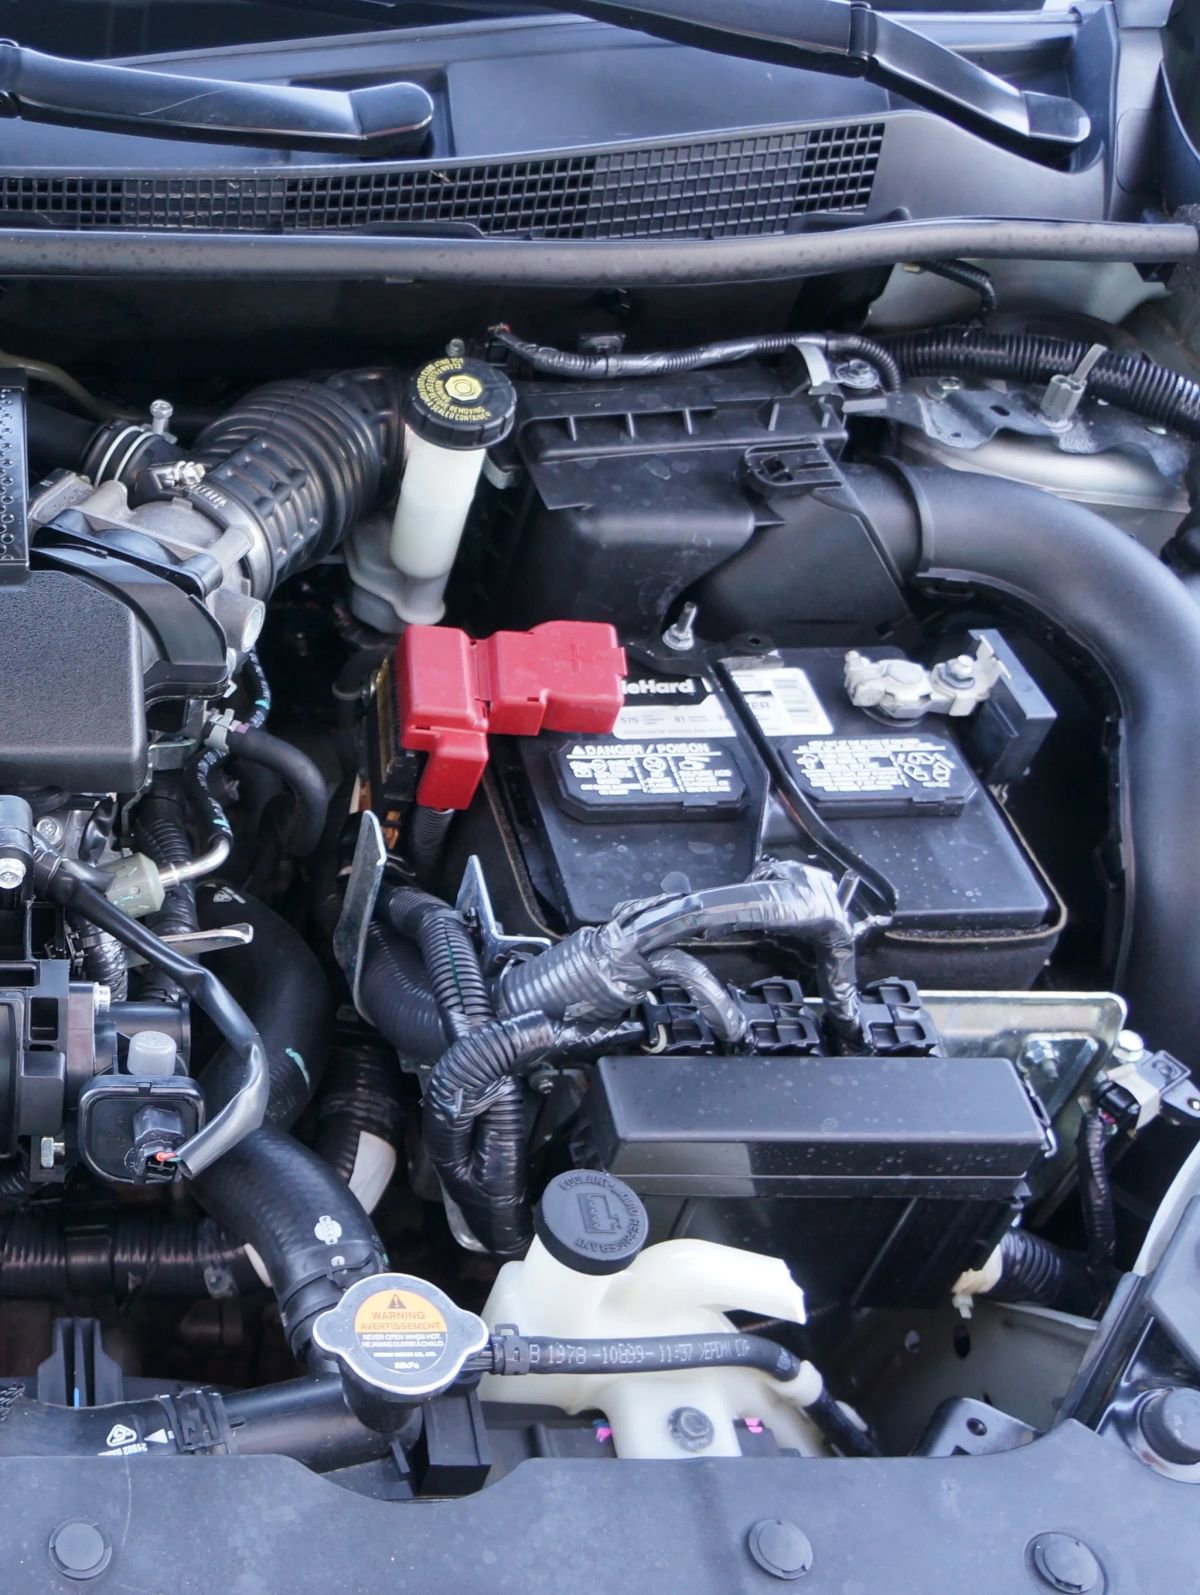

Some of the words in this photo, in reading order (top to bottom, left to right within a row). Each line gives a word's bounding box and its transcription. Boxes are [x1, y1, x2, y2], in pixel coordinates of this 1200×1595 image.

[620, 679, 696, 695] ieHard
[585, 744, 644, 756] DANGER
[656, 743, 710, 754] POISON
[371, 1311, 426, 1320] WARNING
[360, 1321, 441, 1330] AVERTISSEMENT
